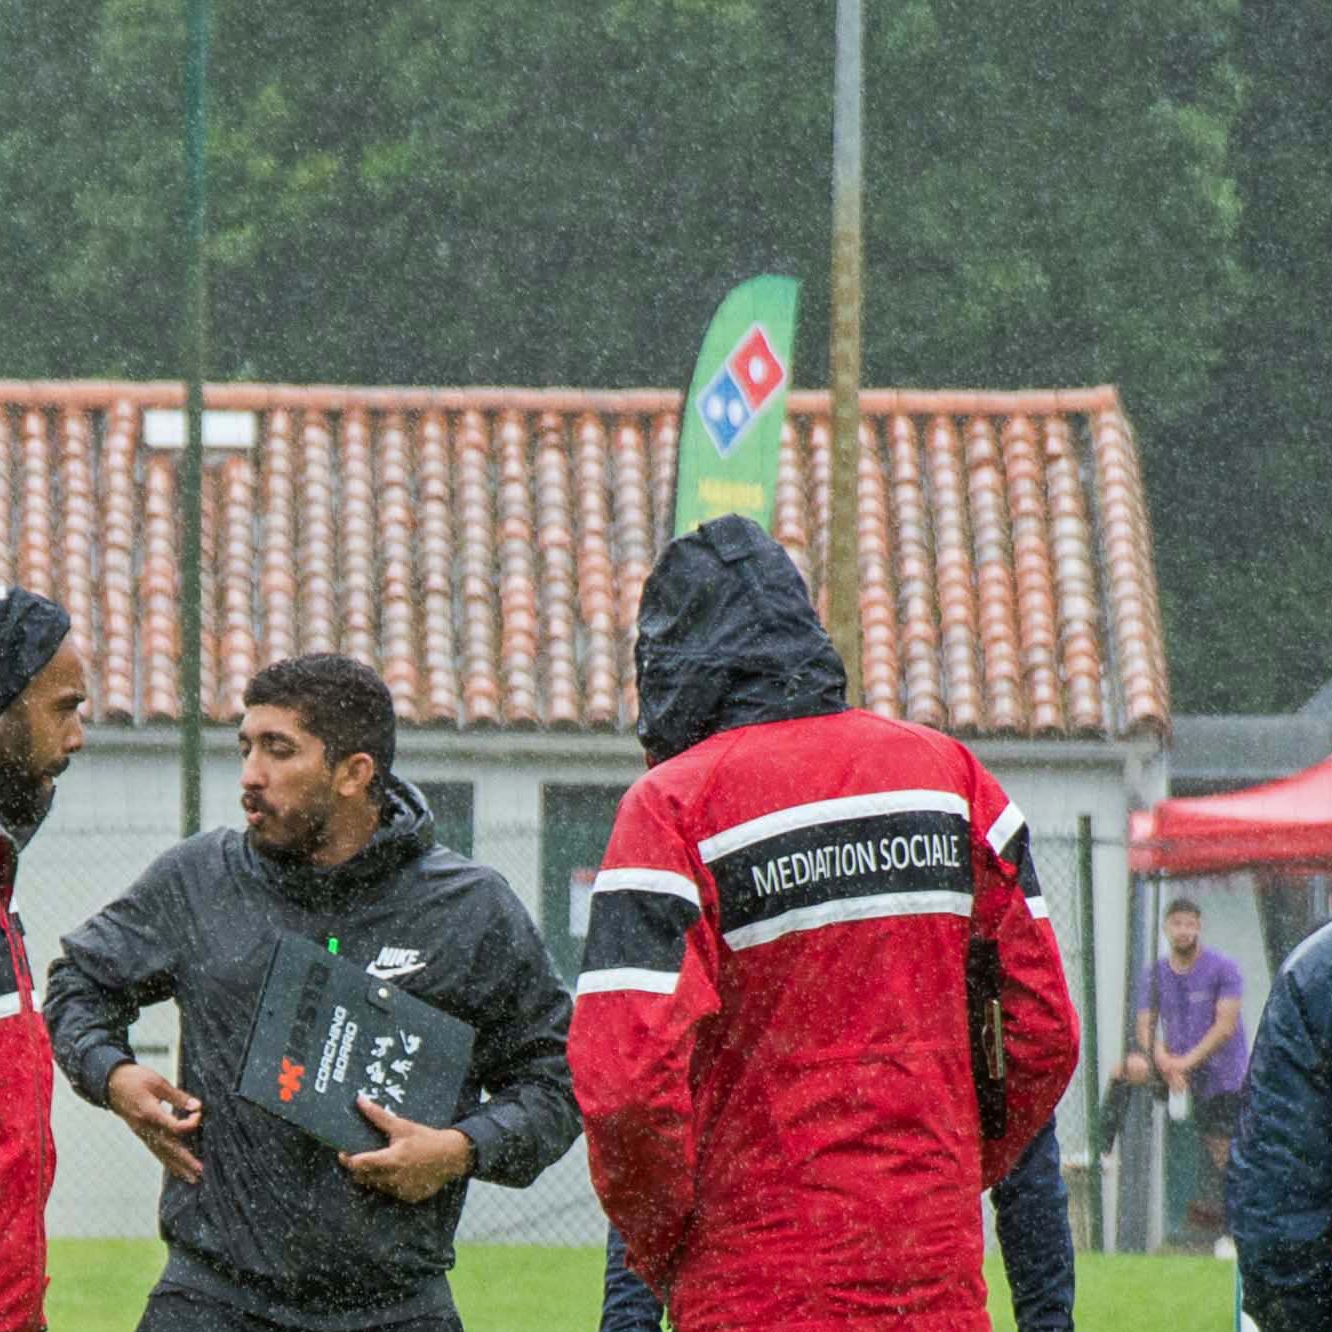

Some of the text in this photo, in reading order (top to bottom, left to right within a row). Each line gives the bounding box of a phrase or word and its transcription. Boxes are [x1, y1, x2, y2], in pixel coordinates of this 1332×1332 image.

[751, 834, 960, 897] MEDIATION SOCIALE
[376, 946, 420, 966] NIKE
[314, 1005, 347, 1094] COACHING
[332, 1021, 358, 1083] BOARD
